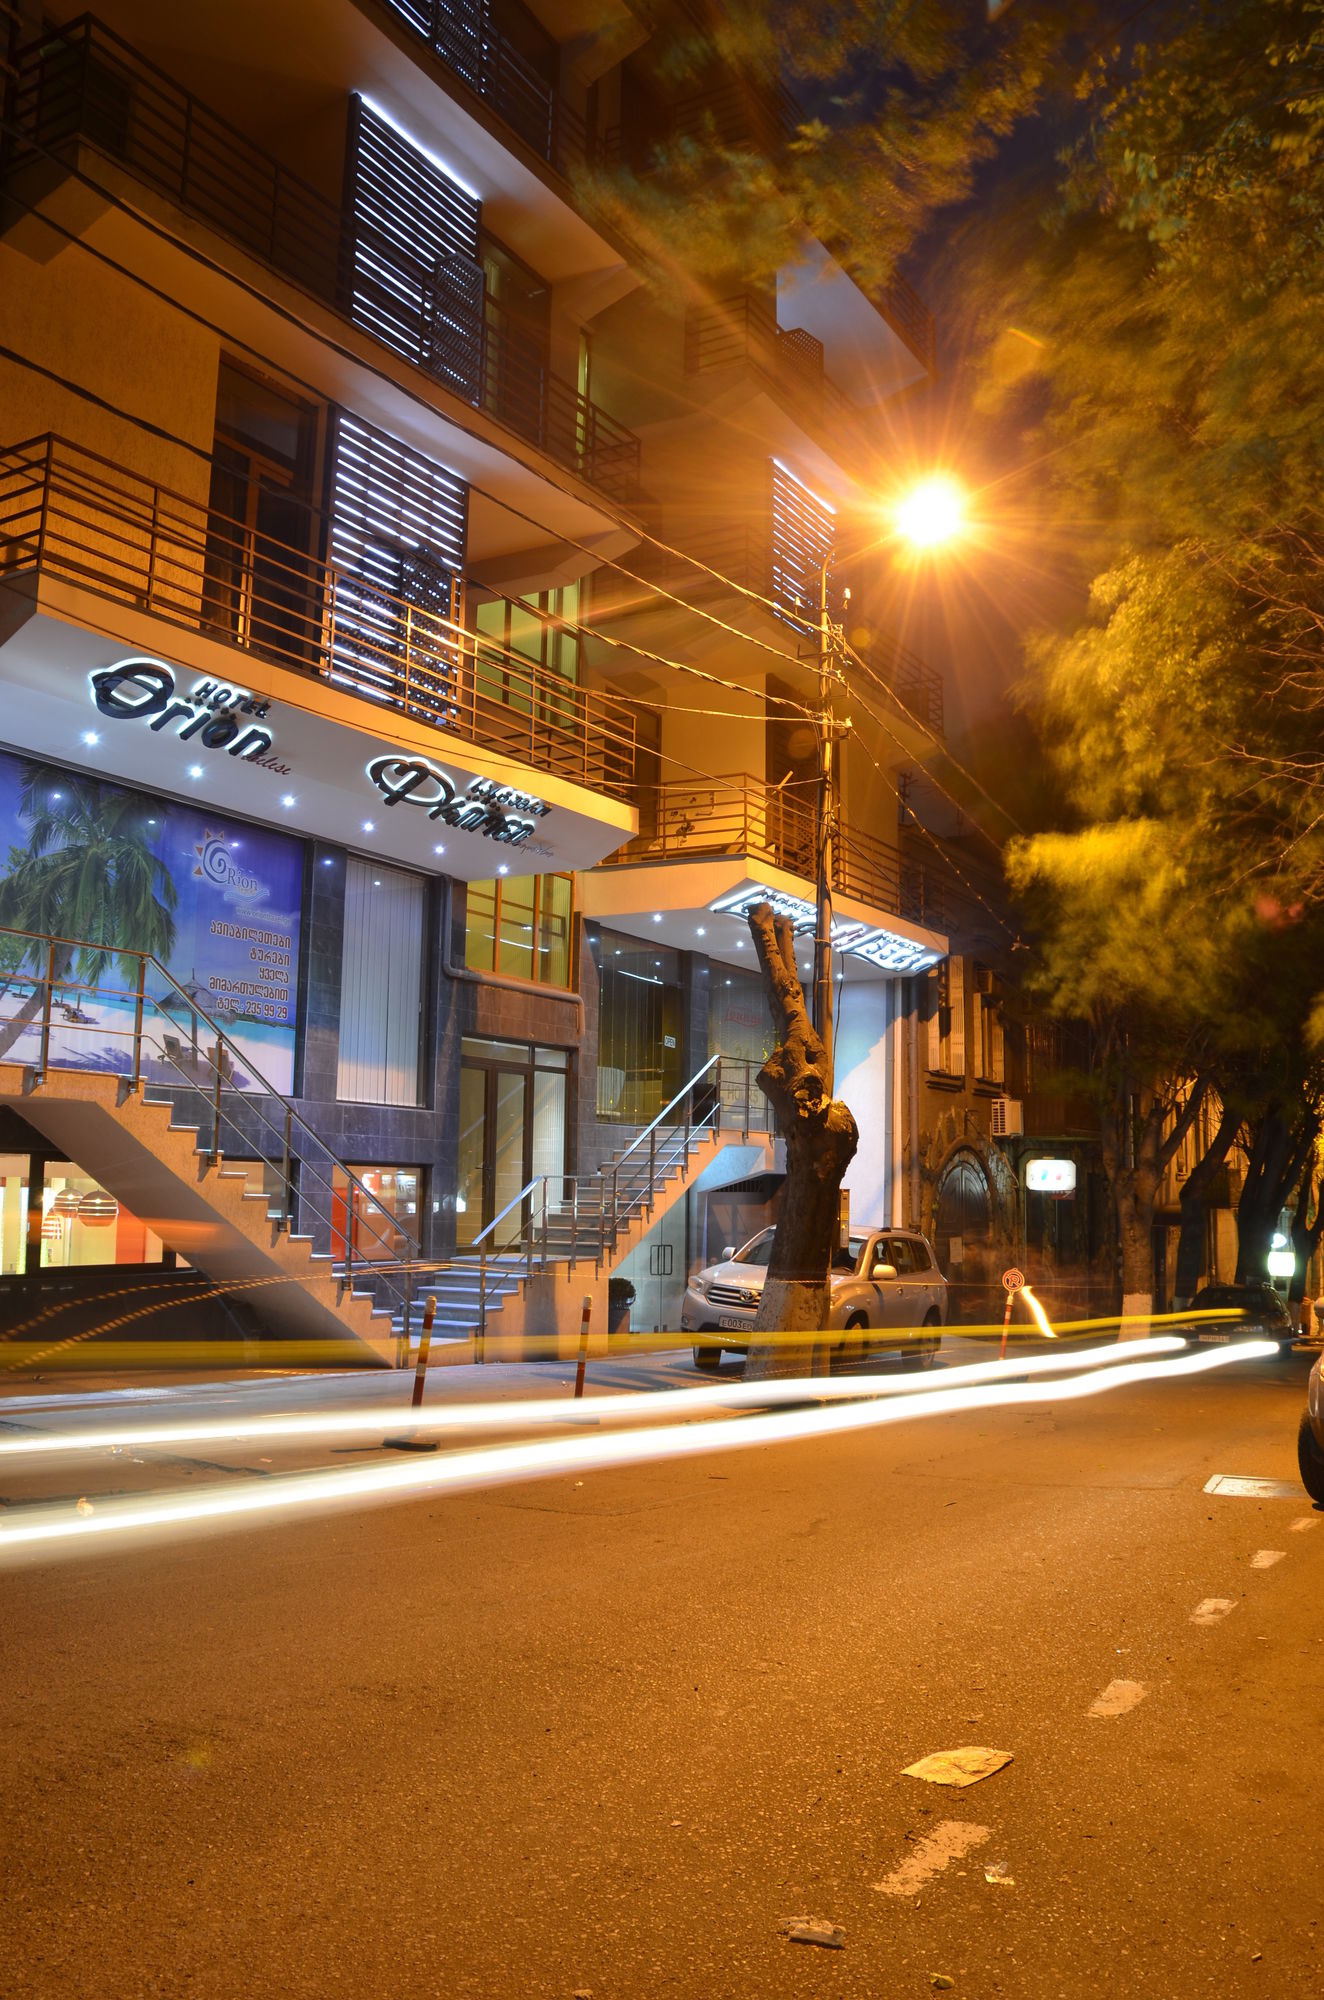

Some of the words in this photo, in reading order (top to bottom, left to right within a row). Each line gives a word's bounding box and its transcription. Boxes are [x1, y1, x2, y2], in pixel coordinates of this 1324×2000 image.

[90, 660, 273, 757] Orion
[194, 680, 272, 720] HOTEL
[210, 920, 291, 949] ავიაბილეთები
[249, 947, 290, 967] ტურები
[259, 967, 289, 984] ყველა
[209, 976, 288, 1002] მიმართულებით
[245, 1001, 261, 1015] 235
[264, 1004, 274, 1017] 99
[276, 1006, 288, 1019] 29
